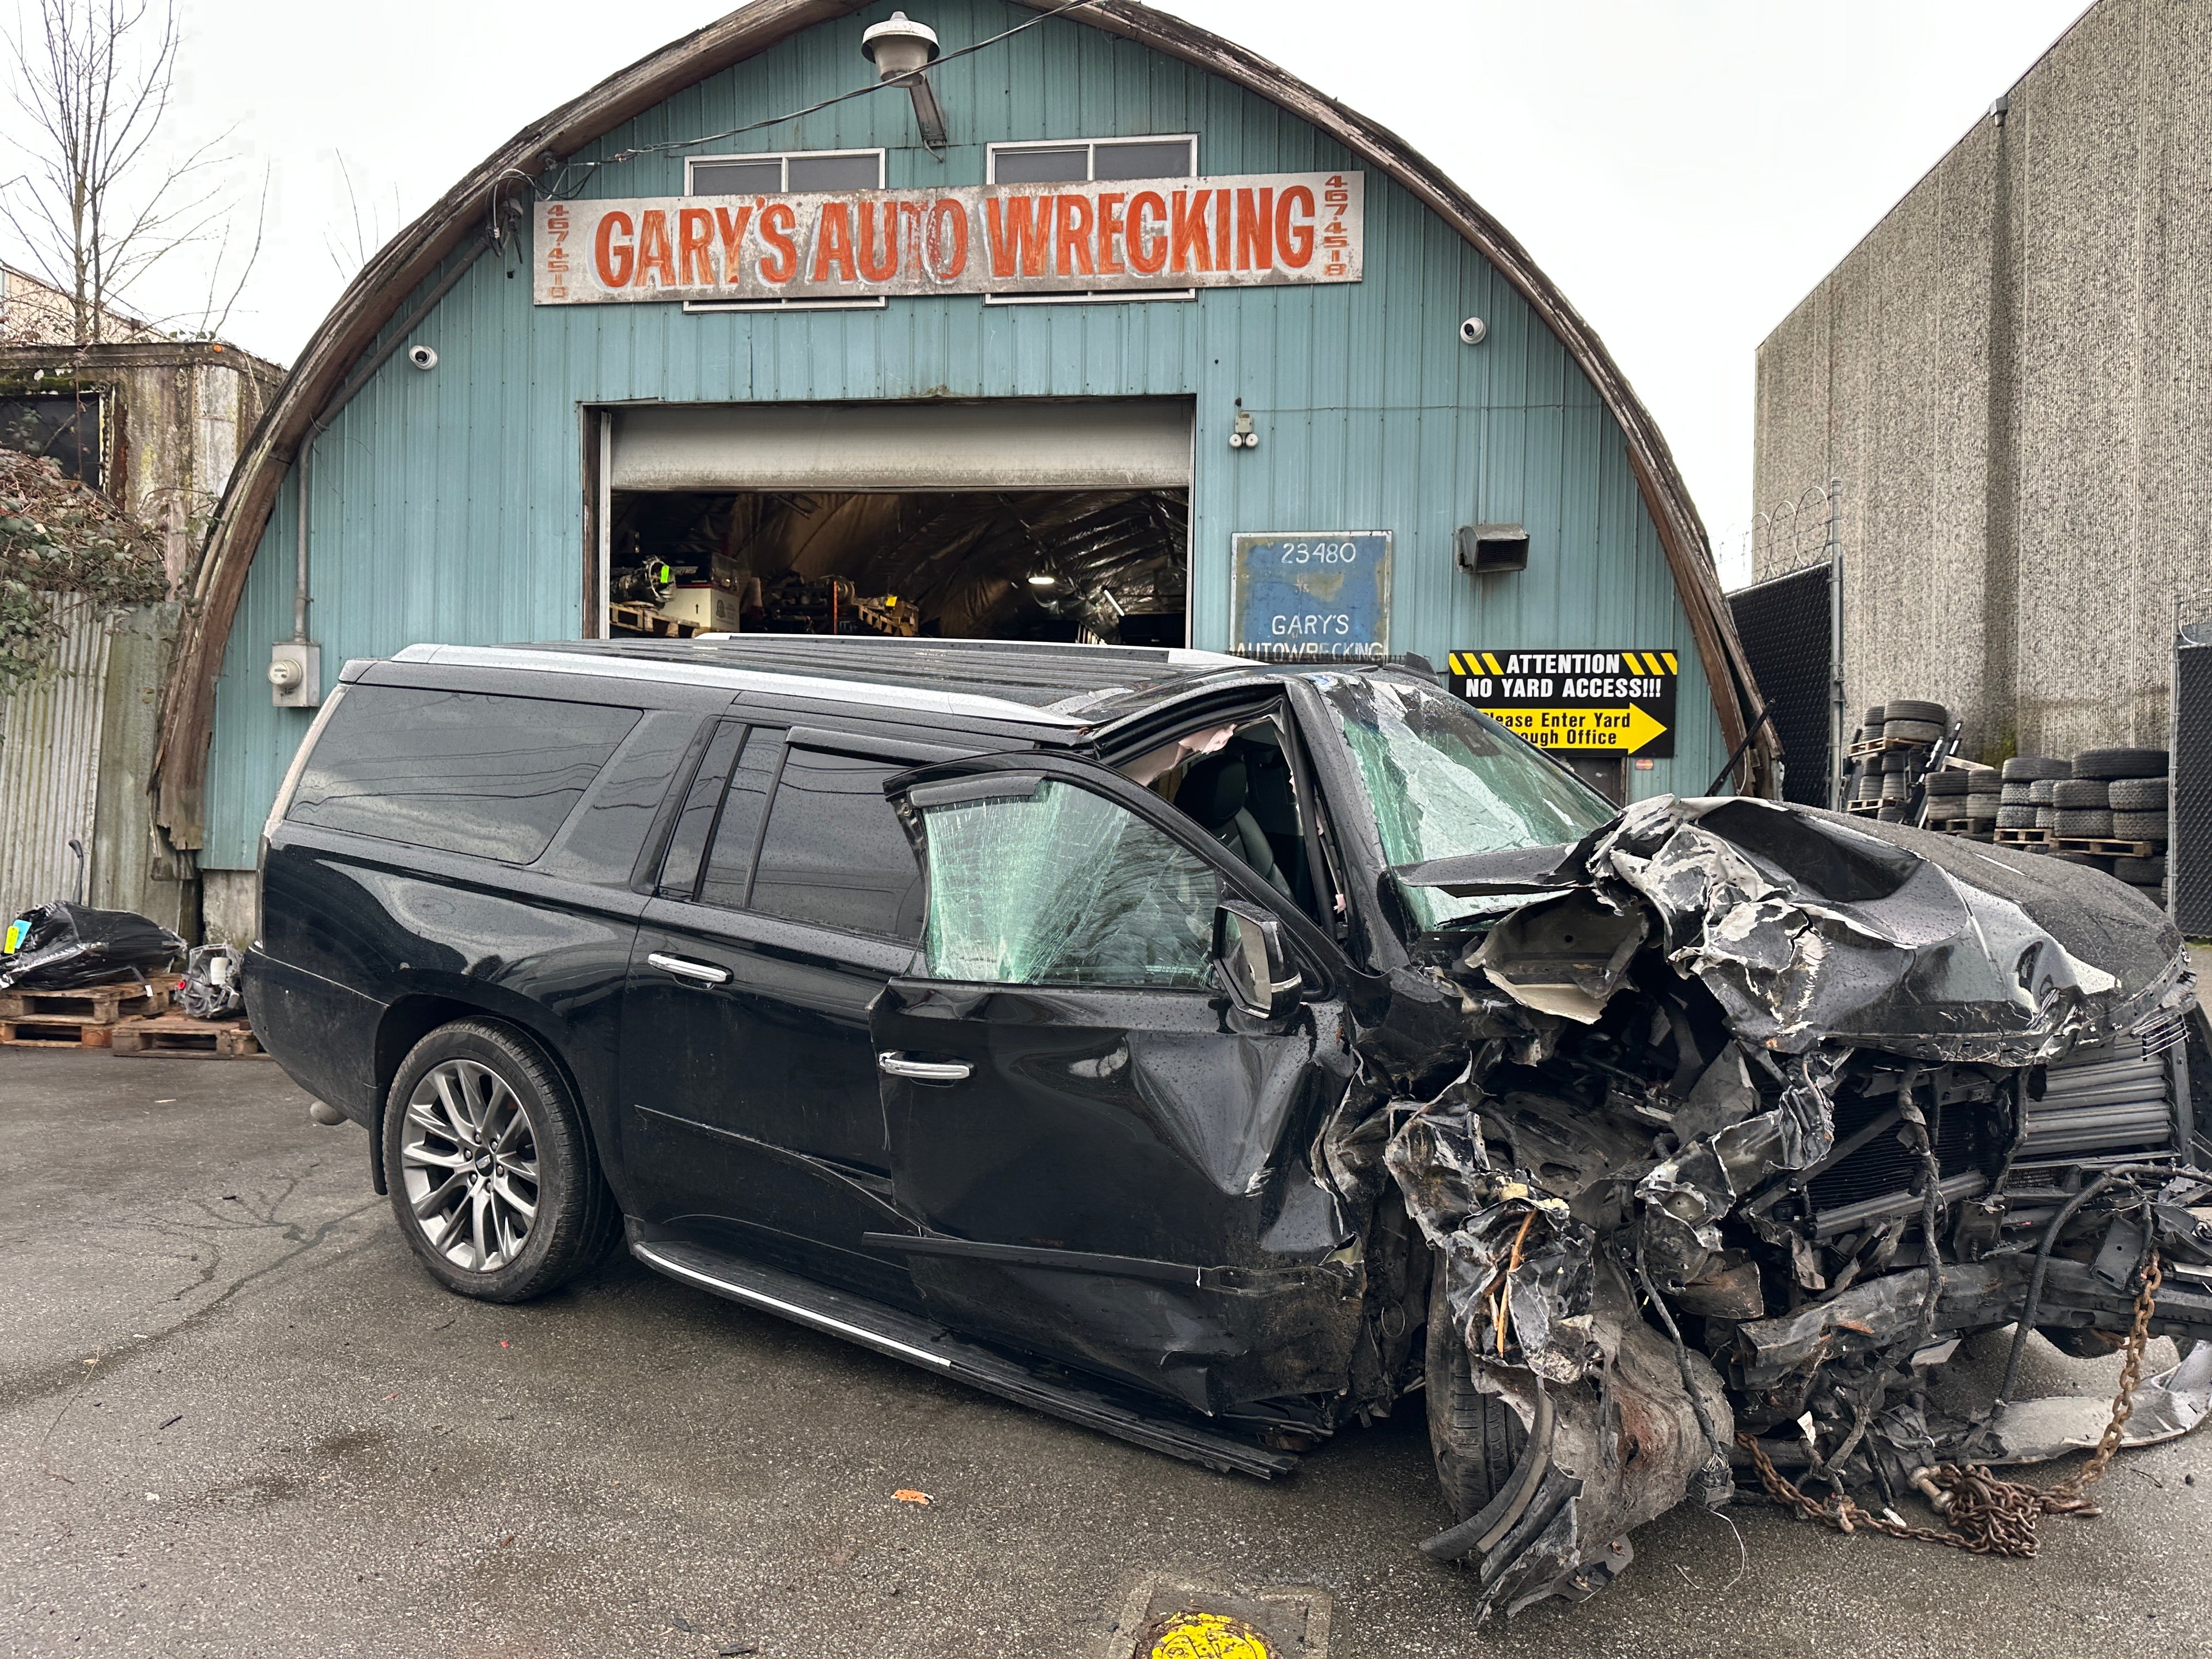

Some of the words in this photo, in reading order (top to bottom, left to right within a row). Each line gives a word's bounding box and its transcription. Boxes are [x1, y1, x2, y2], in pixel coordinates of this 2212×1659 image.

[594, 197, 797, 288] GARY'S
[813, 199, 969, 282] AUTO
[985, 185, 1315, 278] WRECKING
[1281, 542, 1357, 564] 23480
[1271, 614, 1350, 635] GARY'S
[1506, 654, 1620, 674] ATTENTION
[1465, 678, 1493, 698] NO
[1501, 679, 1554, 698] YARD
[1562, 678, 1661, 698] ACCESS!!!
[1541, 712, 1586, 728] Enter
[1593, 712, 1630, 728] Yard
[1566, 729, 1617, 744] Office
